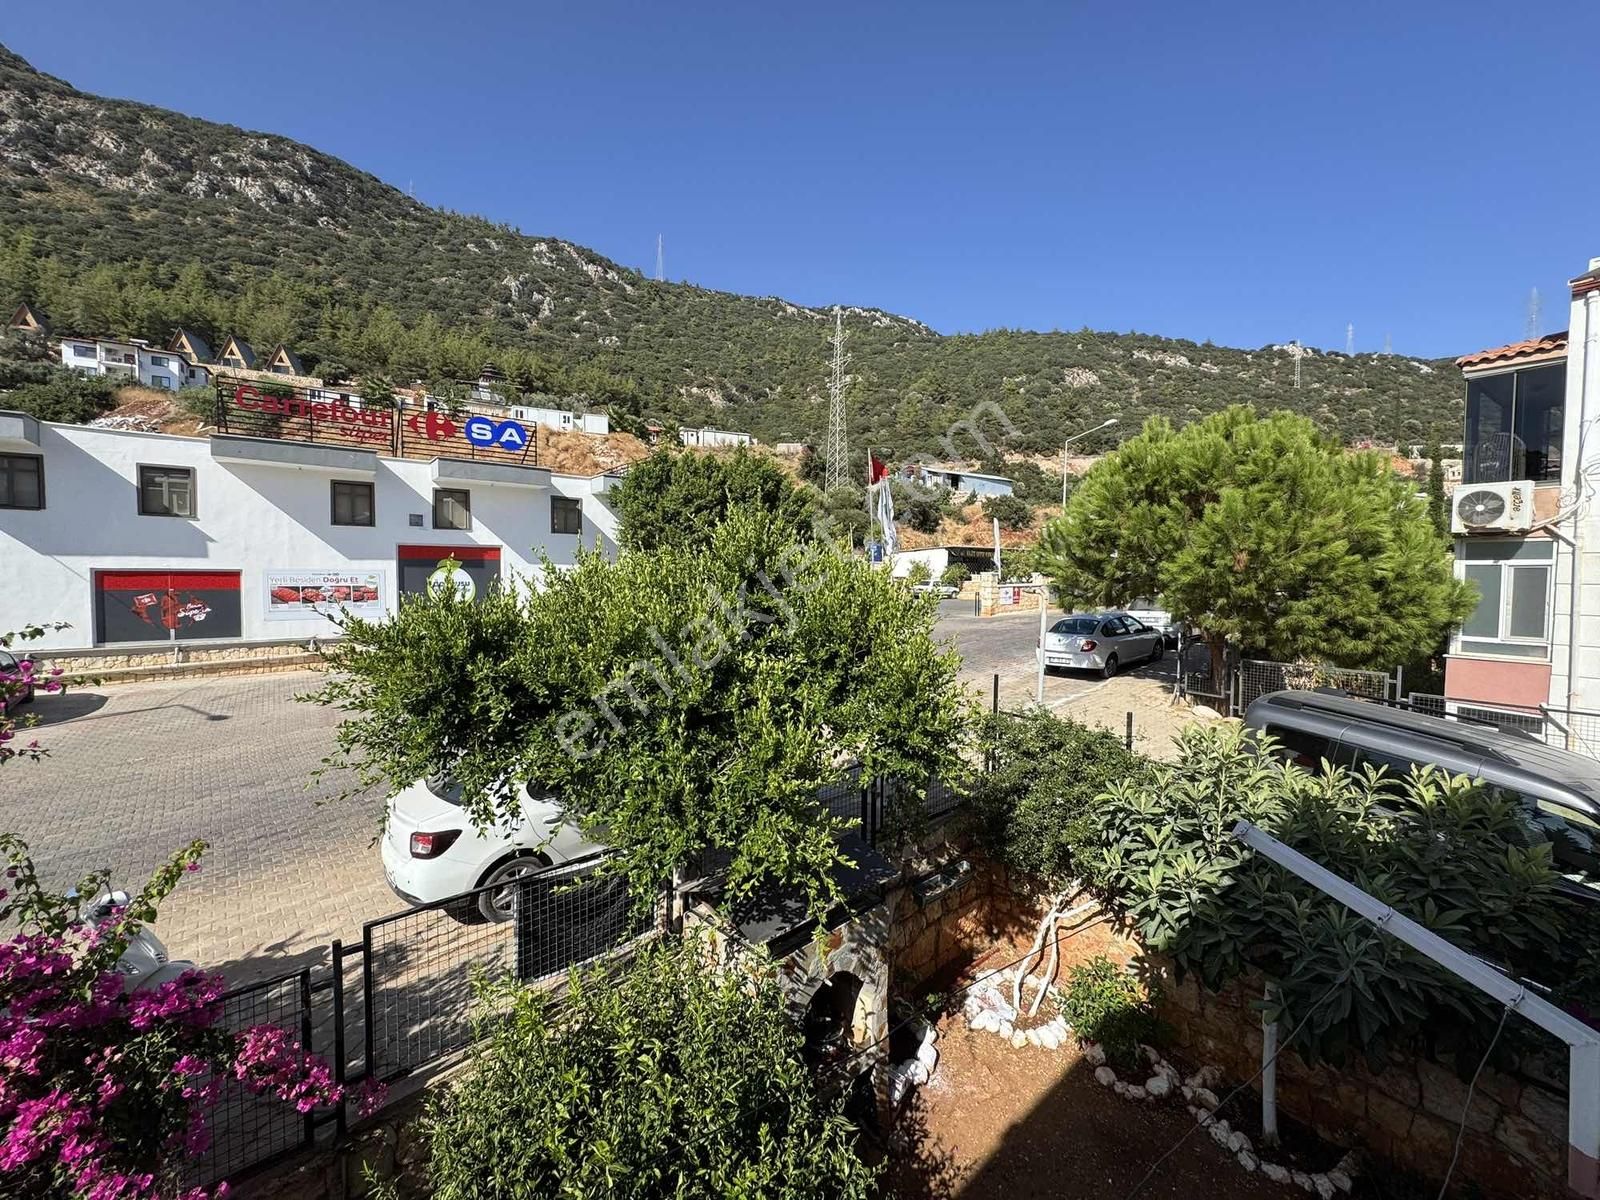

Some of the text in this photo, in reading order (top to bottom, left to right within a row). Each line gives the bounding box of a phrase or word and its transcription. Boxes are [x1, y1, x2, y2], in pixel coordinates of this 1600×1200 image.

[235, 385, 390, 427] Carrefour
[471, 423, 523, 445] SA
[322, 576, 349, 584] Doğru
